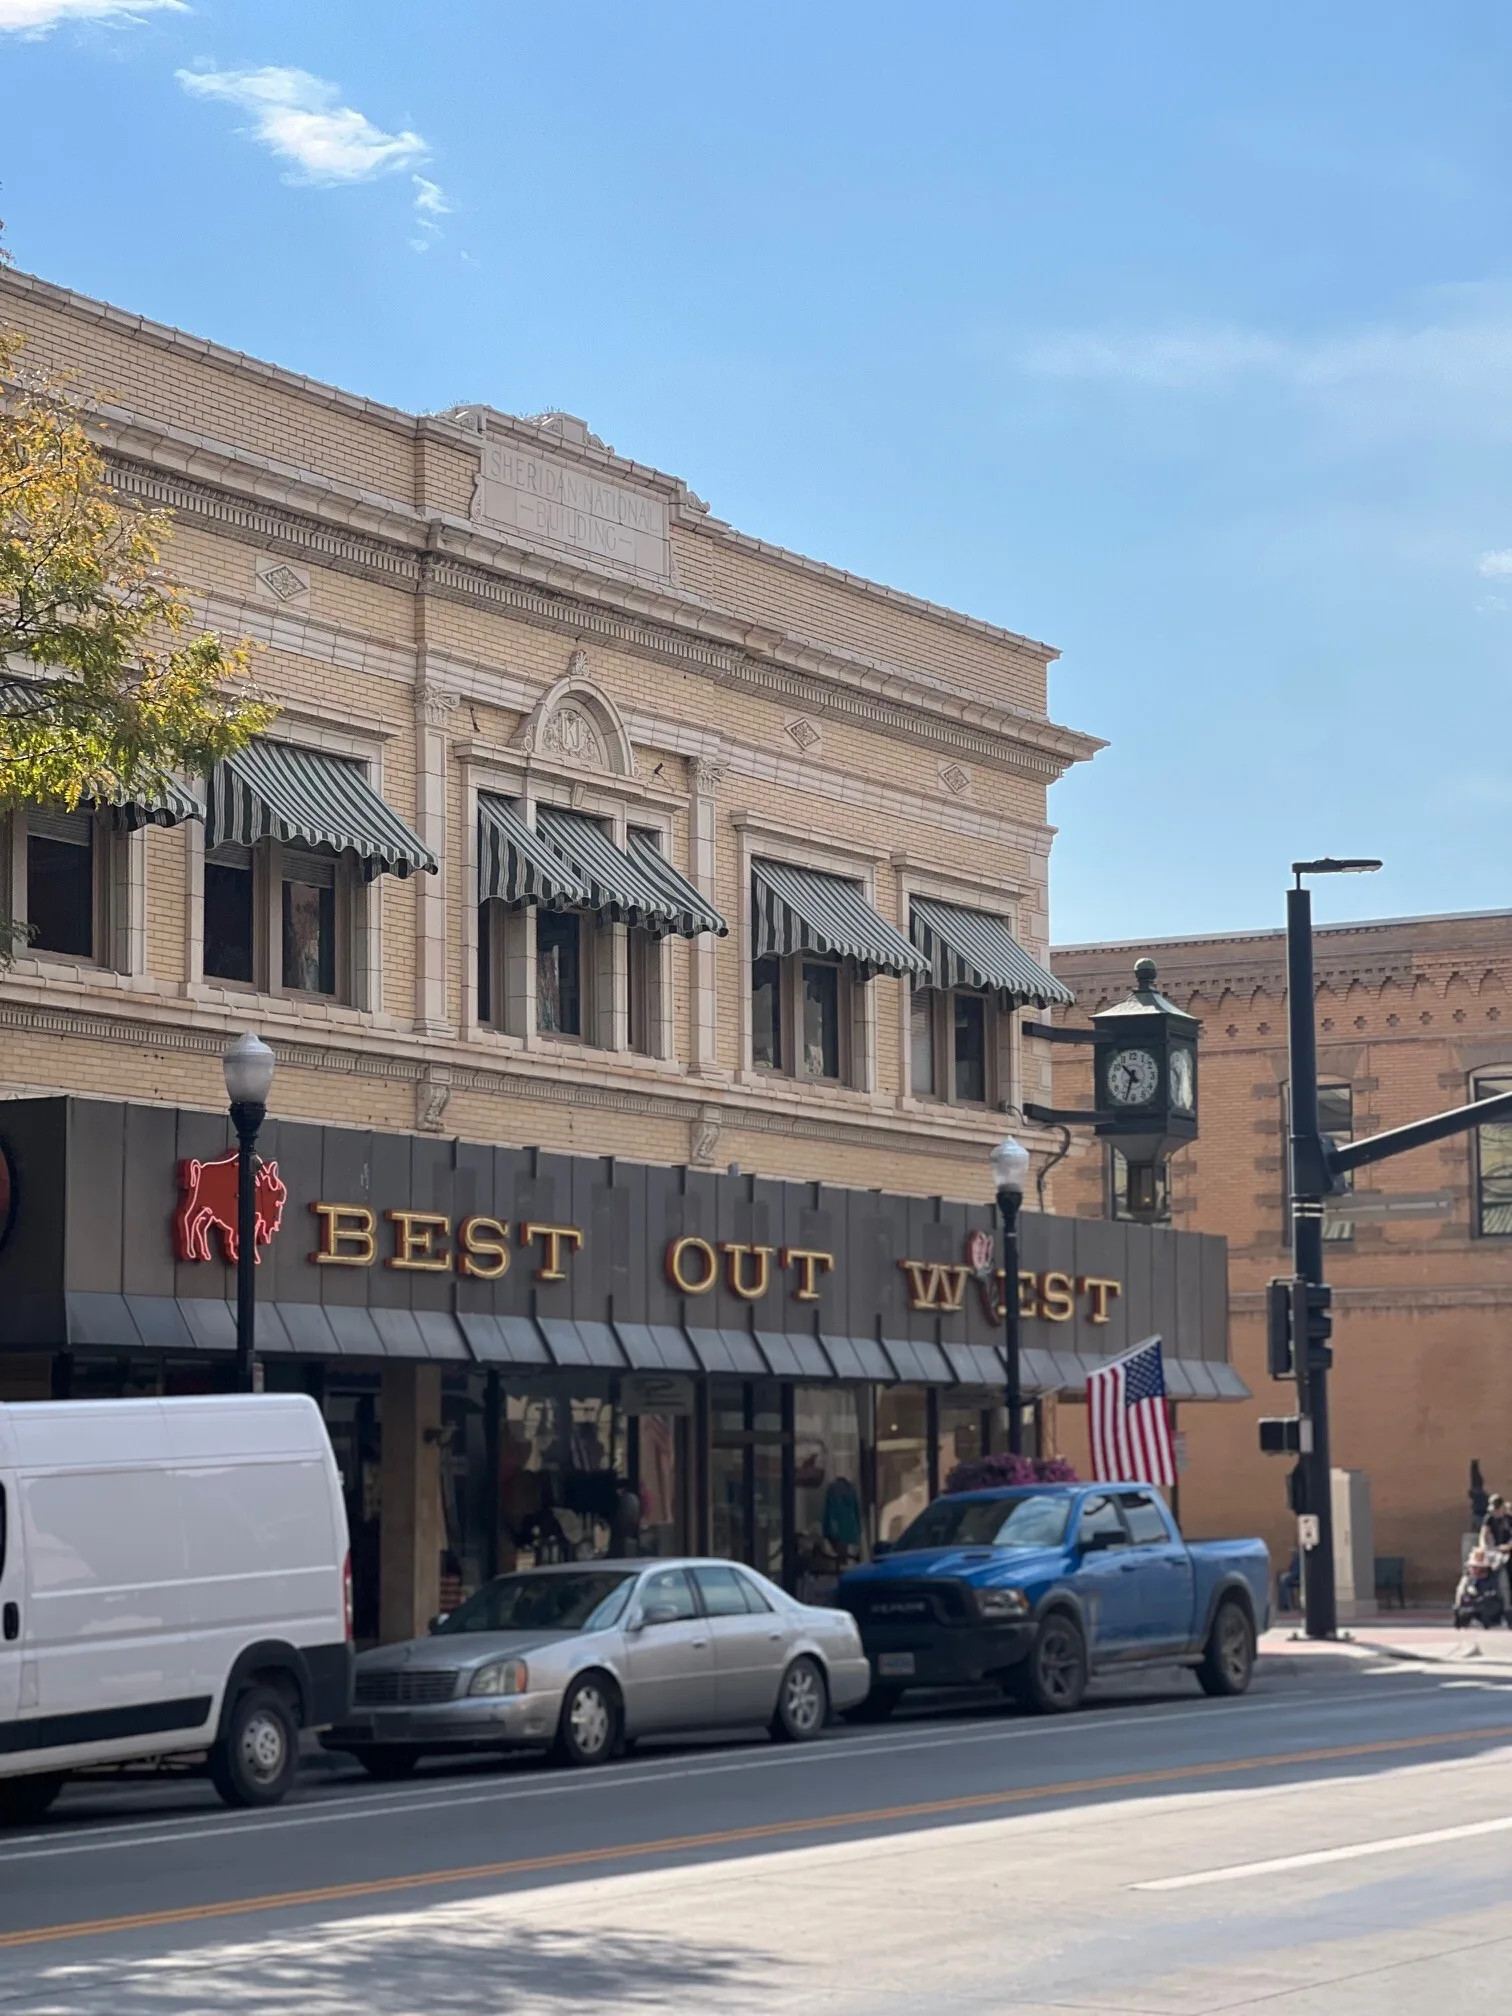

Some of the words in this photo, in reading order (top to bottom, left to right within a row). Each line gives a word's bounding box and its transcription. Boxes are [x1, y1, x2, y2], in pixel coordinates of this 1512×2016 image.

[491, 451, 578, 501] SHERIDAN
[582, 479, 660, 533] NATIONAL
[535, 501, 617, 551] BUILDING
[1129, 1052, 1137, 1060] 12
[310, 1201, 585, 1282] BEST
[665, 1236, 835, 1300] OUT
[898, 1258, 1122, 1324] WEST
